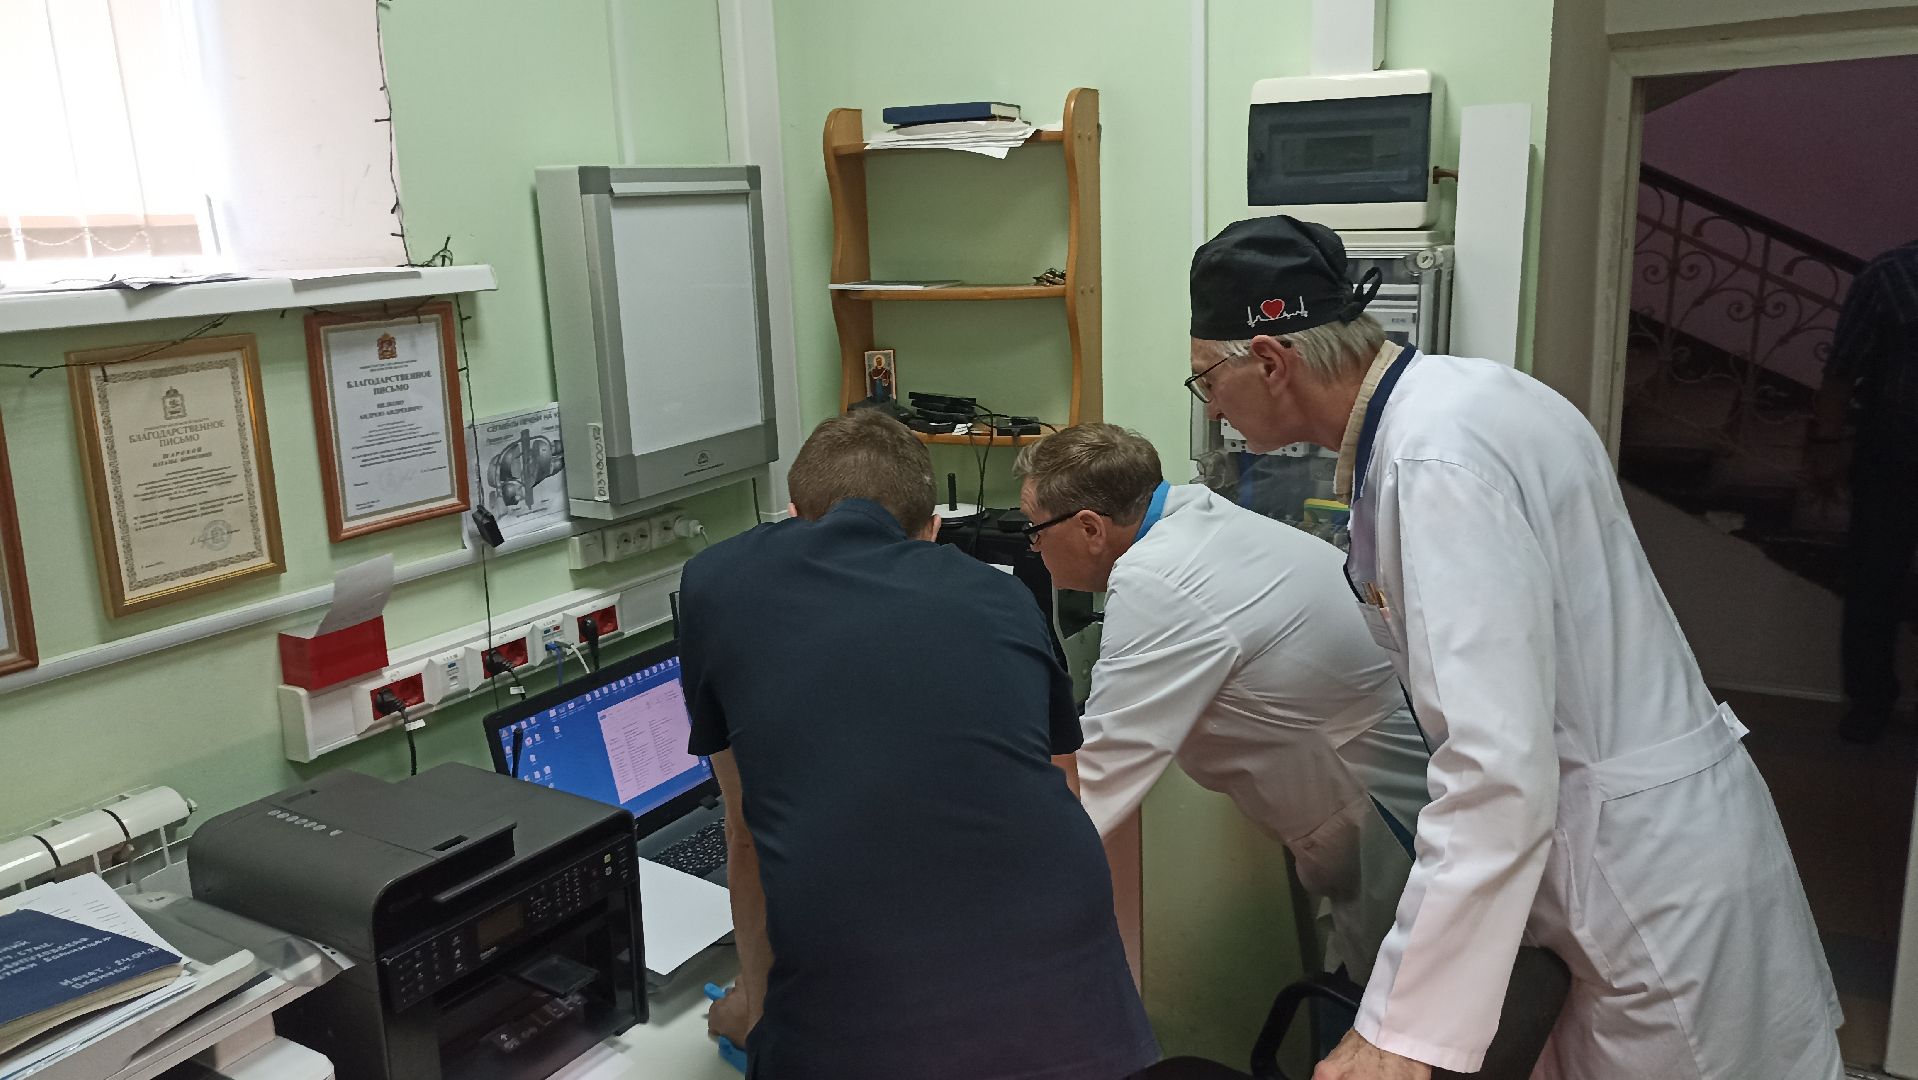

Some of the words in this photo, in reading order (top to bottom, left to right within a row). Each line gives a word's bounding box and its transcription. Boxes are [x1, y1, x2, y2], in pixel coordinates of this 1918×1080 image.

[346, 370, 432, 388] БЛАГОДАРСТВЕННОЕ
[373, 384, 410, 396] ПИСЬМО
[129, 420, 225, 443] БЛАГОДАРСТВЕННОЕ
[159, 433, 201, 448] ПИСЬМО
